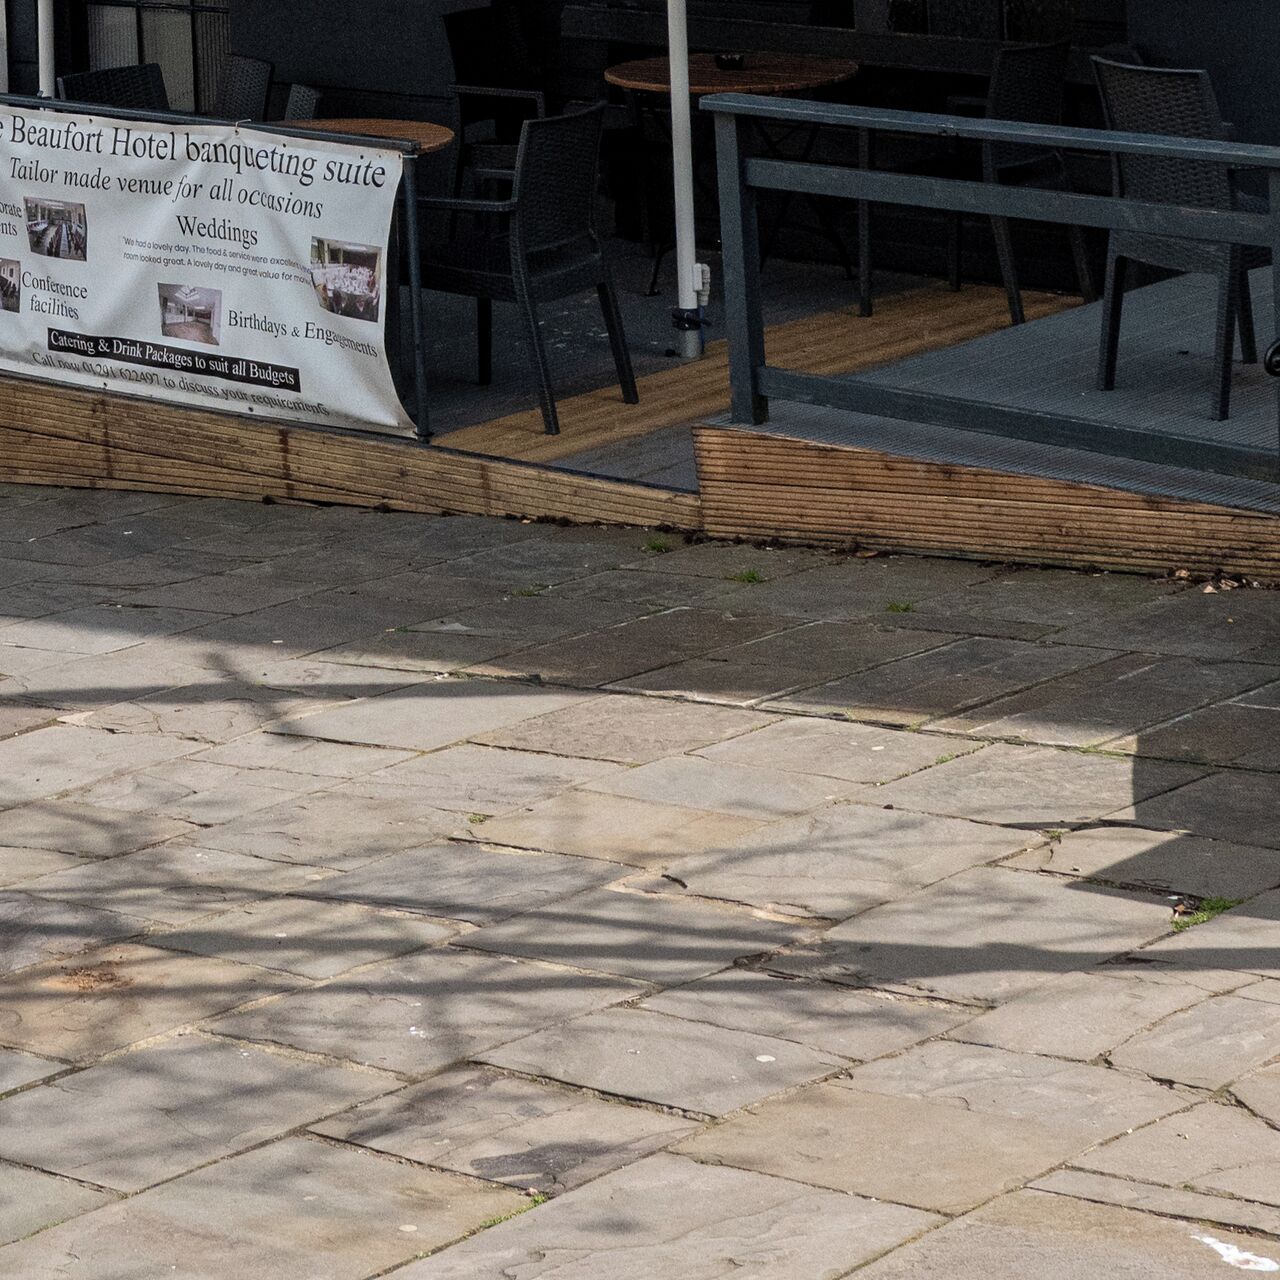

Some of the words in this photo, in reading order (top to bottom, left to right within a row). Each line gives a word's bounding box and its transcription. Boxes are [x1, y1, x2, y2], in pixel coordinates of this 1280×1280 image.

[10, 114, 104, 153] Beaufort
[110, 126, 177, 161] Hotel
[184, 132, 318, 186] banqueting
[323, 155, 386, 188] suite
[9, 156, 58, 184] Tailor
[63, 167, 111, 191] made
[116, 176, 173, 196] venue
[172, 174, 203, 203] for
[209, 178, 233, 203] all
[237, 187, 324, 219] occasions
[176, 214, 259, 250] Weddings
[22, 270, 88, 301] Conference
[30, 294, 80, 321] facilities
[50, 330, 95, 355] Catering
[98, 339, 110, 353] &
[113, 339, 143, 359] Drink
[145, 344, 193, 369] Packages
[194, 354, 207, 369] to
[209, 356, 229, 374] suit
[232, 361, 246, 378] all
[249, 362, 295, 386] Budgets
[228, 310, 287, 338] Birthdays
[291, 327, 300, 338] &
[304, 321, 378, 358] Engagements
[32, 351, 56, 368] Call
[163, 375, 176, 389] to
[178, 376, 220, 397] discuss
[221, 386, 249, 402] your
[251, 393, 330, 417] requirements
